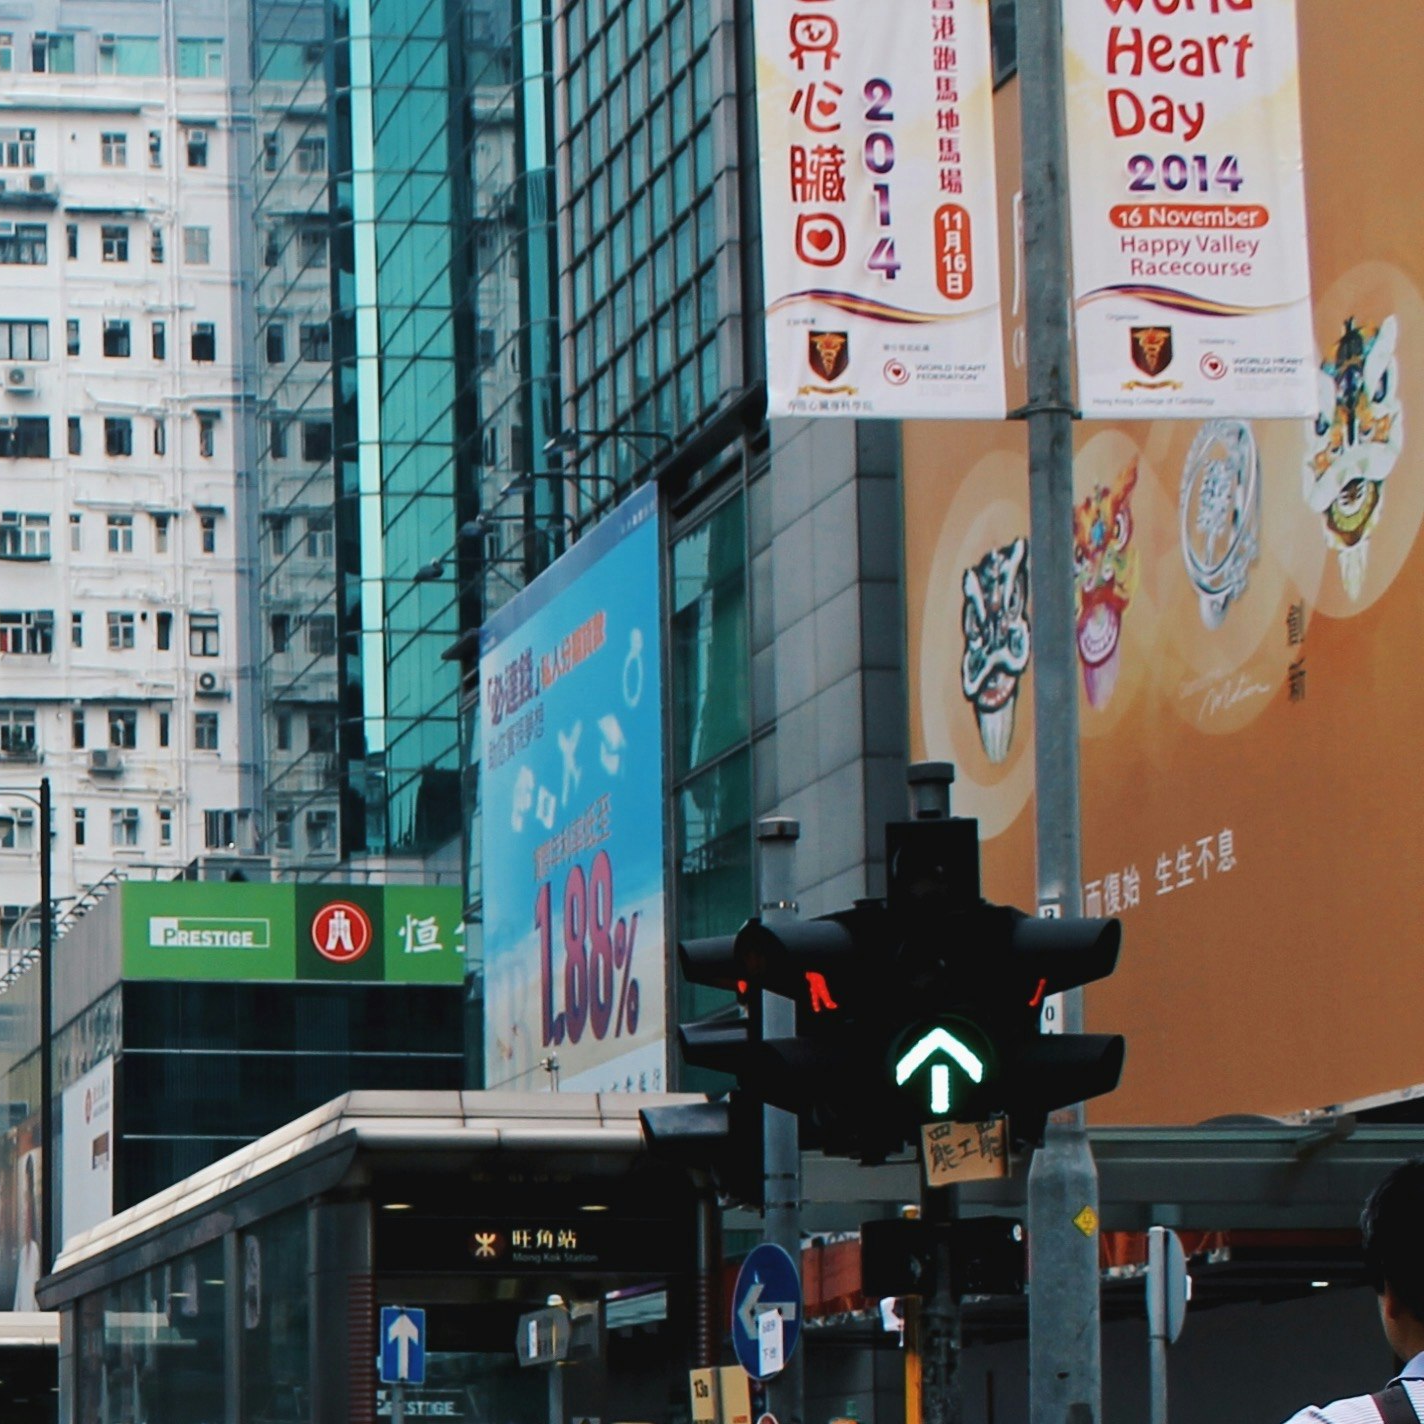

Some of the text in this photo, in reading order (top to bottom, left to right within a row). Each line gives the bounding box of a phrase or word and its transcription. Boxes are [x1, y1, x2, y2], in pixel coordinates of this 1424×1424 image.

[1107, 26, 1253, 79] Heart
[788, 0, 846, 267] 界心臟日
[1107, 87, 1204, 141] Day
[863, 77, 901, 281] 2014
[1127, 153, 1244, 193] 2014
[1118, 207, 1258, 227] 16 November
[1121, 235, 1260, 256] Happy Valley
[1131, 258, 1252, 277] Racecourse
[1156, 827, 1237, 896] 生生不息
[163, 928, 253, 947] PRESTIGE
[398, 914, 465, 953] 恒
[535, 849, 640, 1048] 1.88%
[512, 1229, 577, 1249] 旺角站
[513, 1252, 599, 1264] Mong Kok Station
